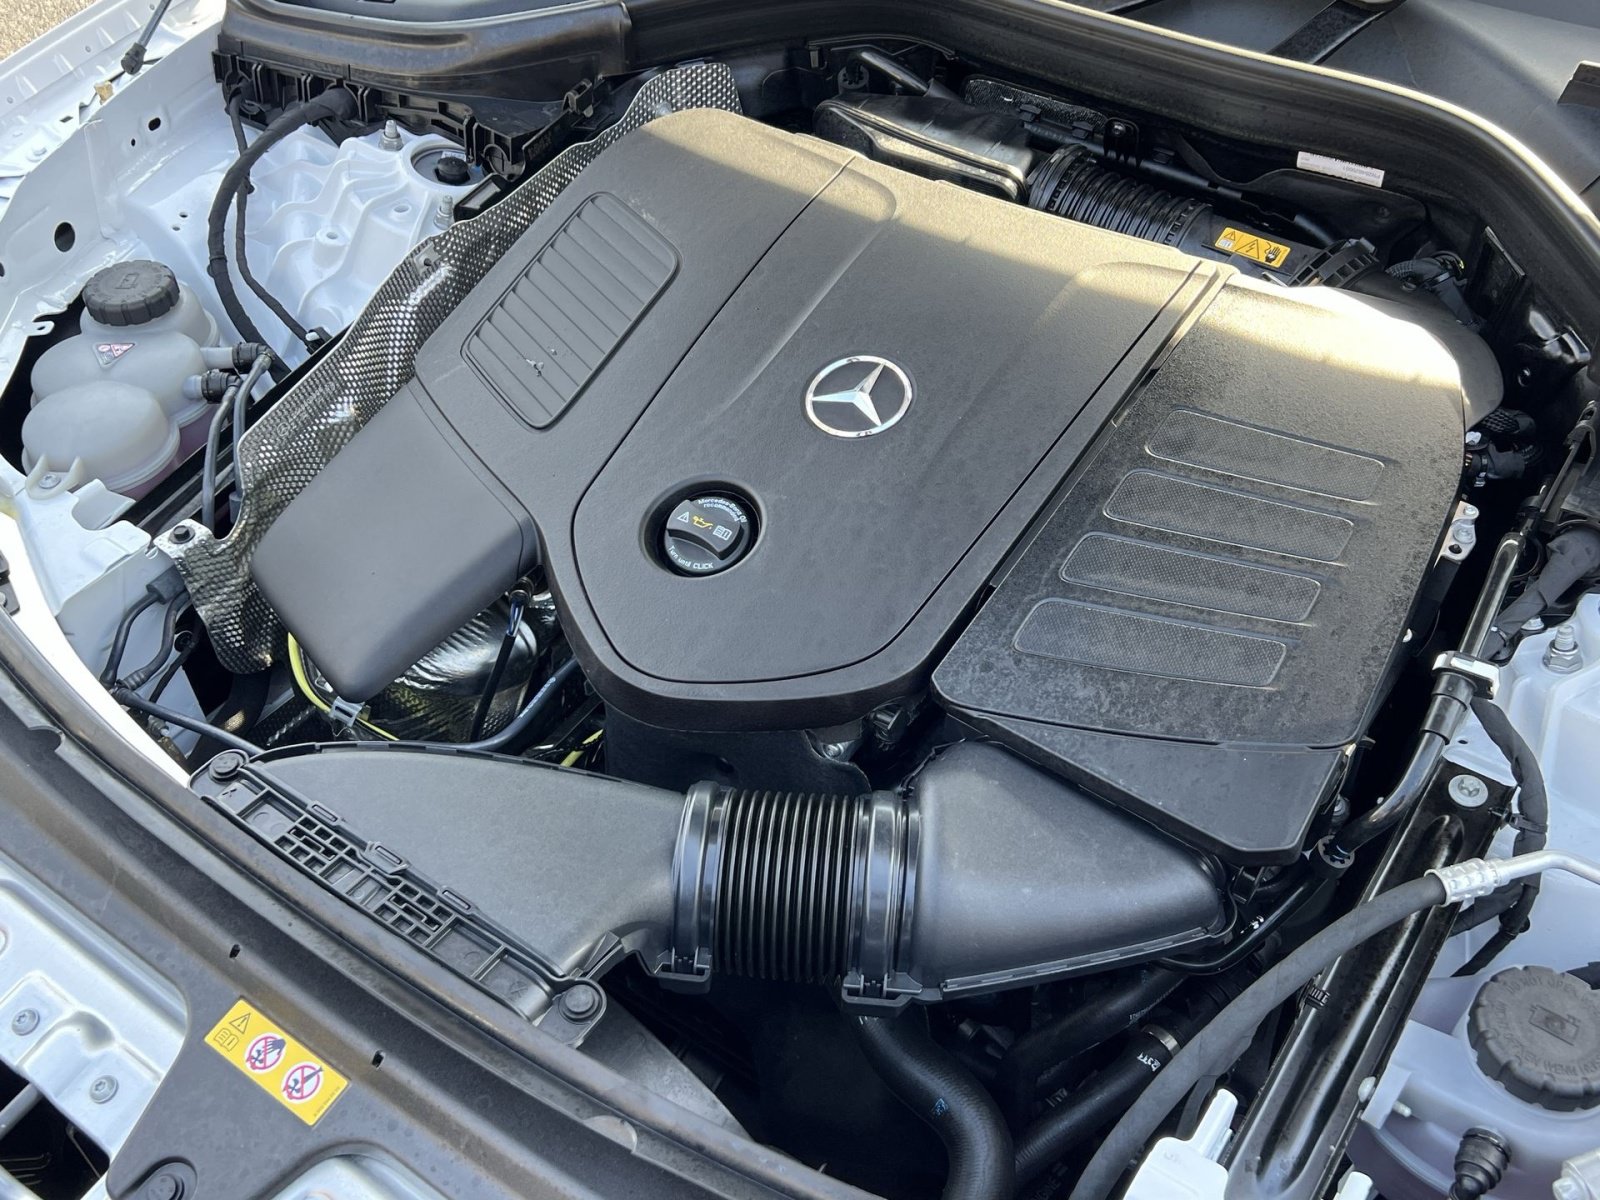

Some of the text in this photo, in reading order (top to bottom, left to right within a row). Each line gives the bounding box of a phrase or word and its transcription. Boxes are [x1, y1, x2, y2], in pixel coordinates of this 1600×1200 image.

[698, 498, 742, 516] Mercedes-Benz
[703, 502, 740, 522] recommended
[668, 545, 714, 570] Turn until CLICK
